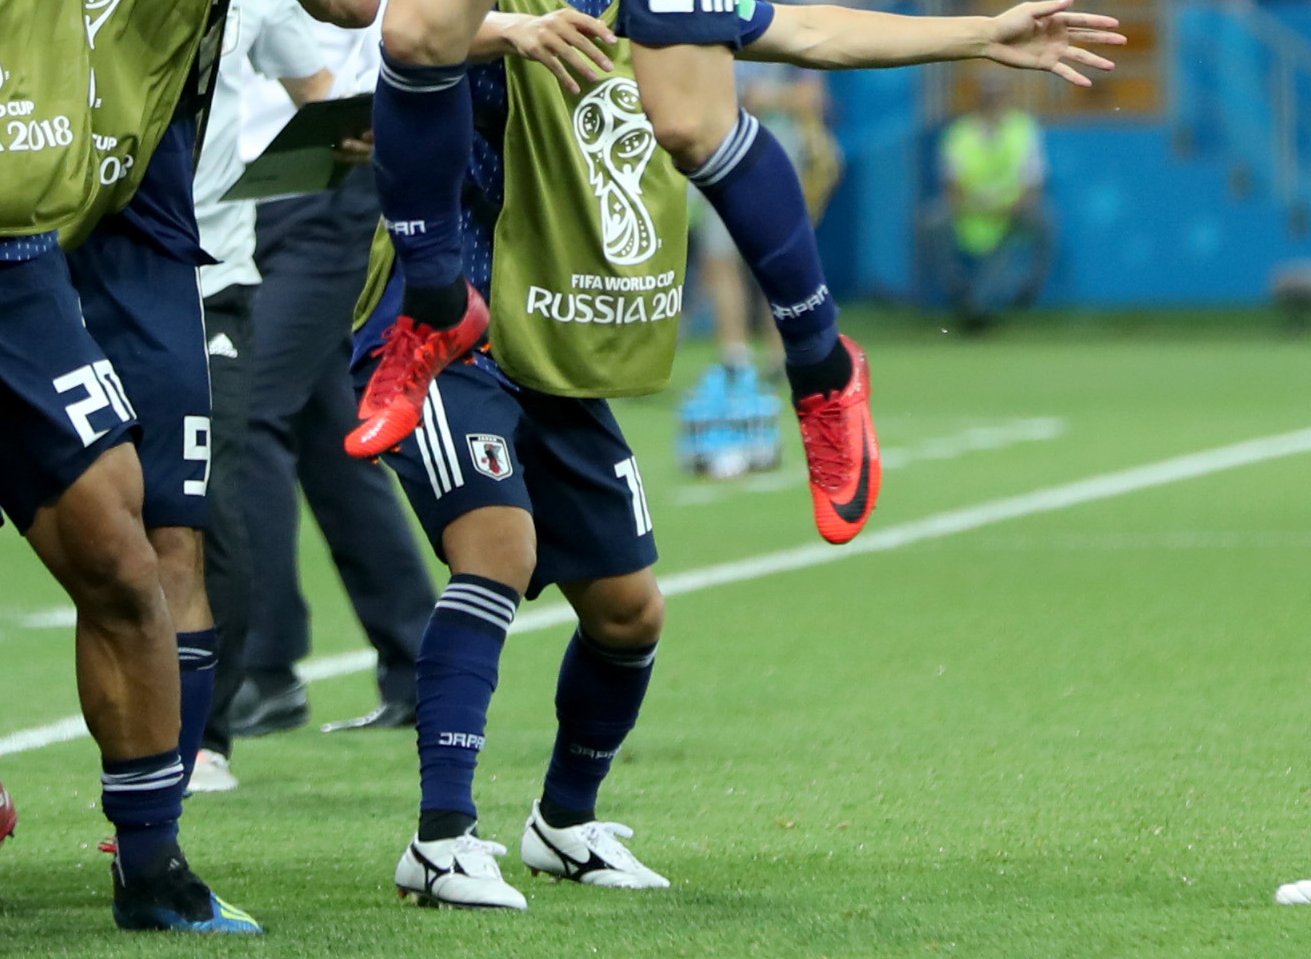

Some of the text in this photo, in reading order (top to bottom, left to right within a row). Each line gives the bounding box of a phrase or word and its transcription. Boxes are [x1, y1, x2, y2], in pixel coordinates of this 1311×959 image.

[7, 100, 35, 116] CUP
[7, 115, 74, 151] 2018
[571, 270, 675, 291] FIFA WORLD CUP
[527, 285, 647, 324] RUSSIA
[183, 415, 211, 497] 9
